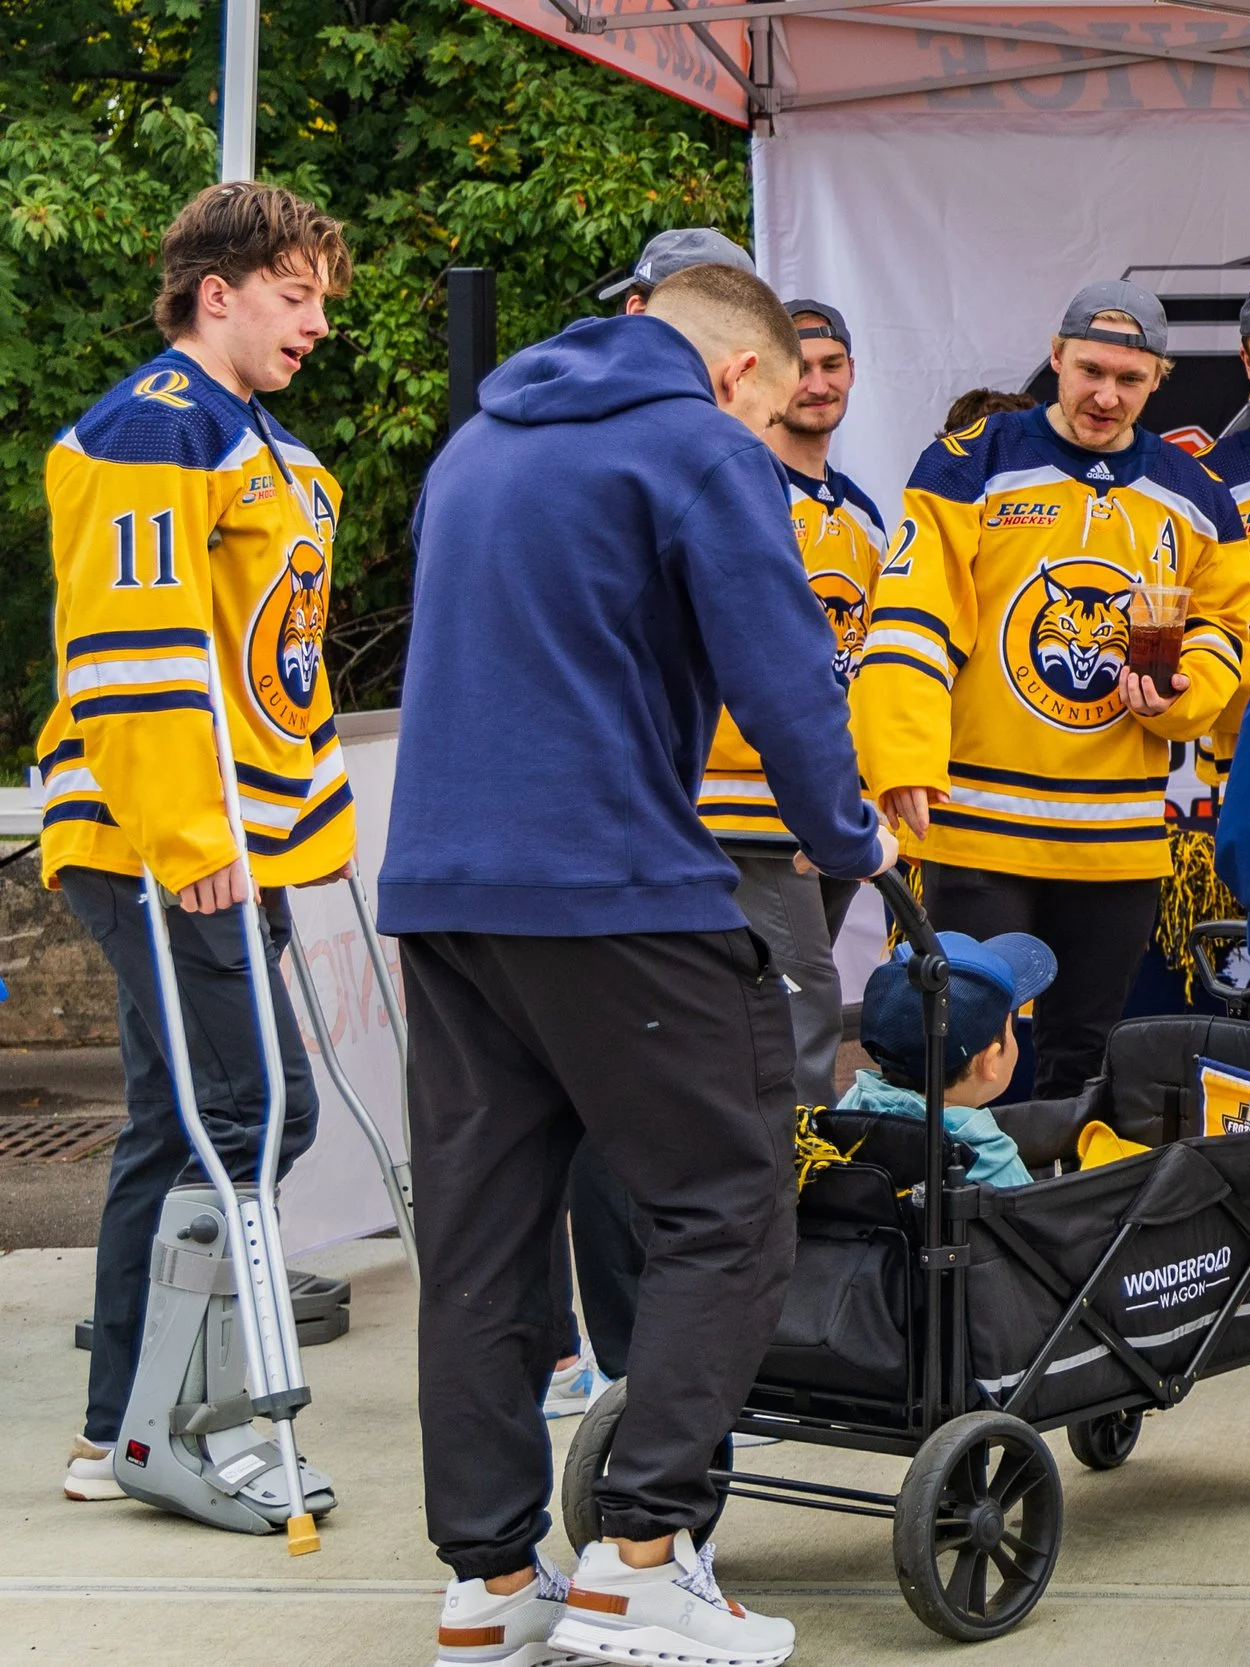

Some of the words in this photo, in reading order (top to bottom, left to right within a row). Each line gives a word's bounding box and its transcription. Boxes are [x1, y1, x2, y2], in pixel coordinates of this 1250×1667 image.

[1086, 470, 1115, 482] adidas
[311, 477, 337, 544] A
[996, 502, 1062, 517] ECAC
[1003, 515, 1057, 526] HOCKEY
[111, 508, 182, 588] 11
[1151, 516, 1178, 573] A
[1015, 664, 1124, 722] QUINNIPI
[1123, 1245, 1232, 1298] WONDERFOLD
[1160, 1280, 1206, 1309] WAGON
